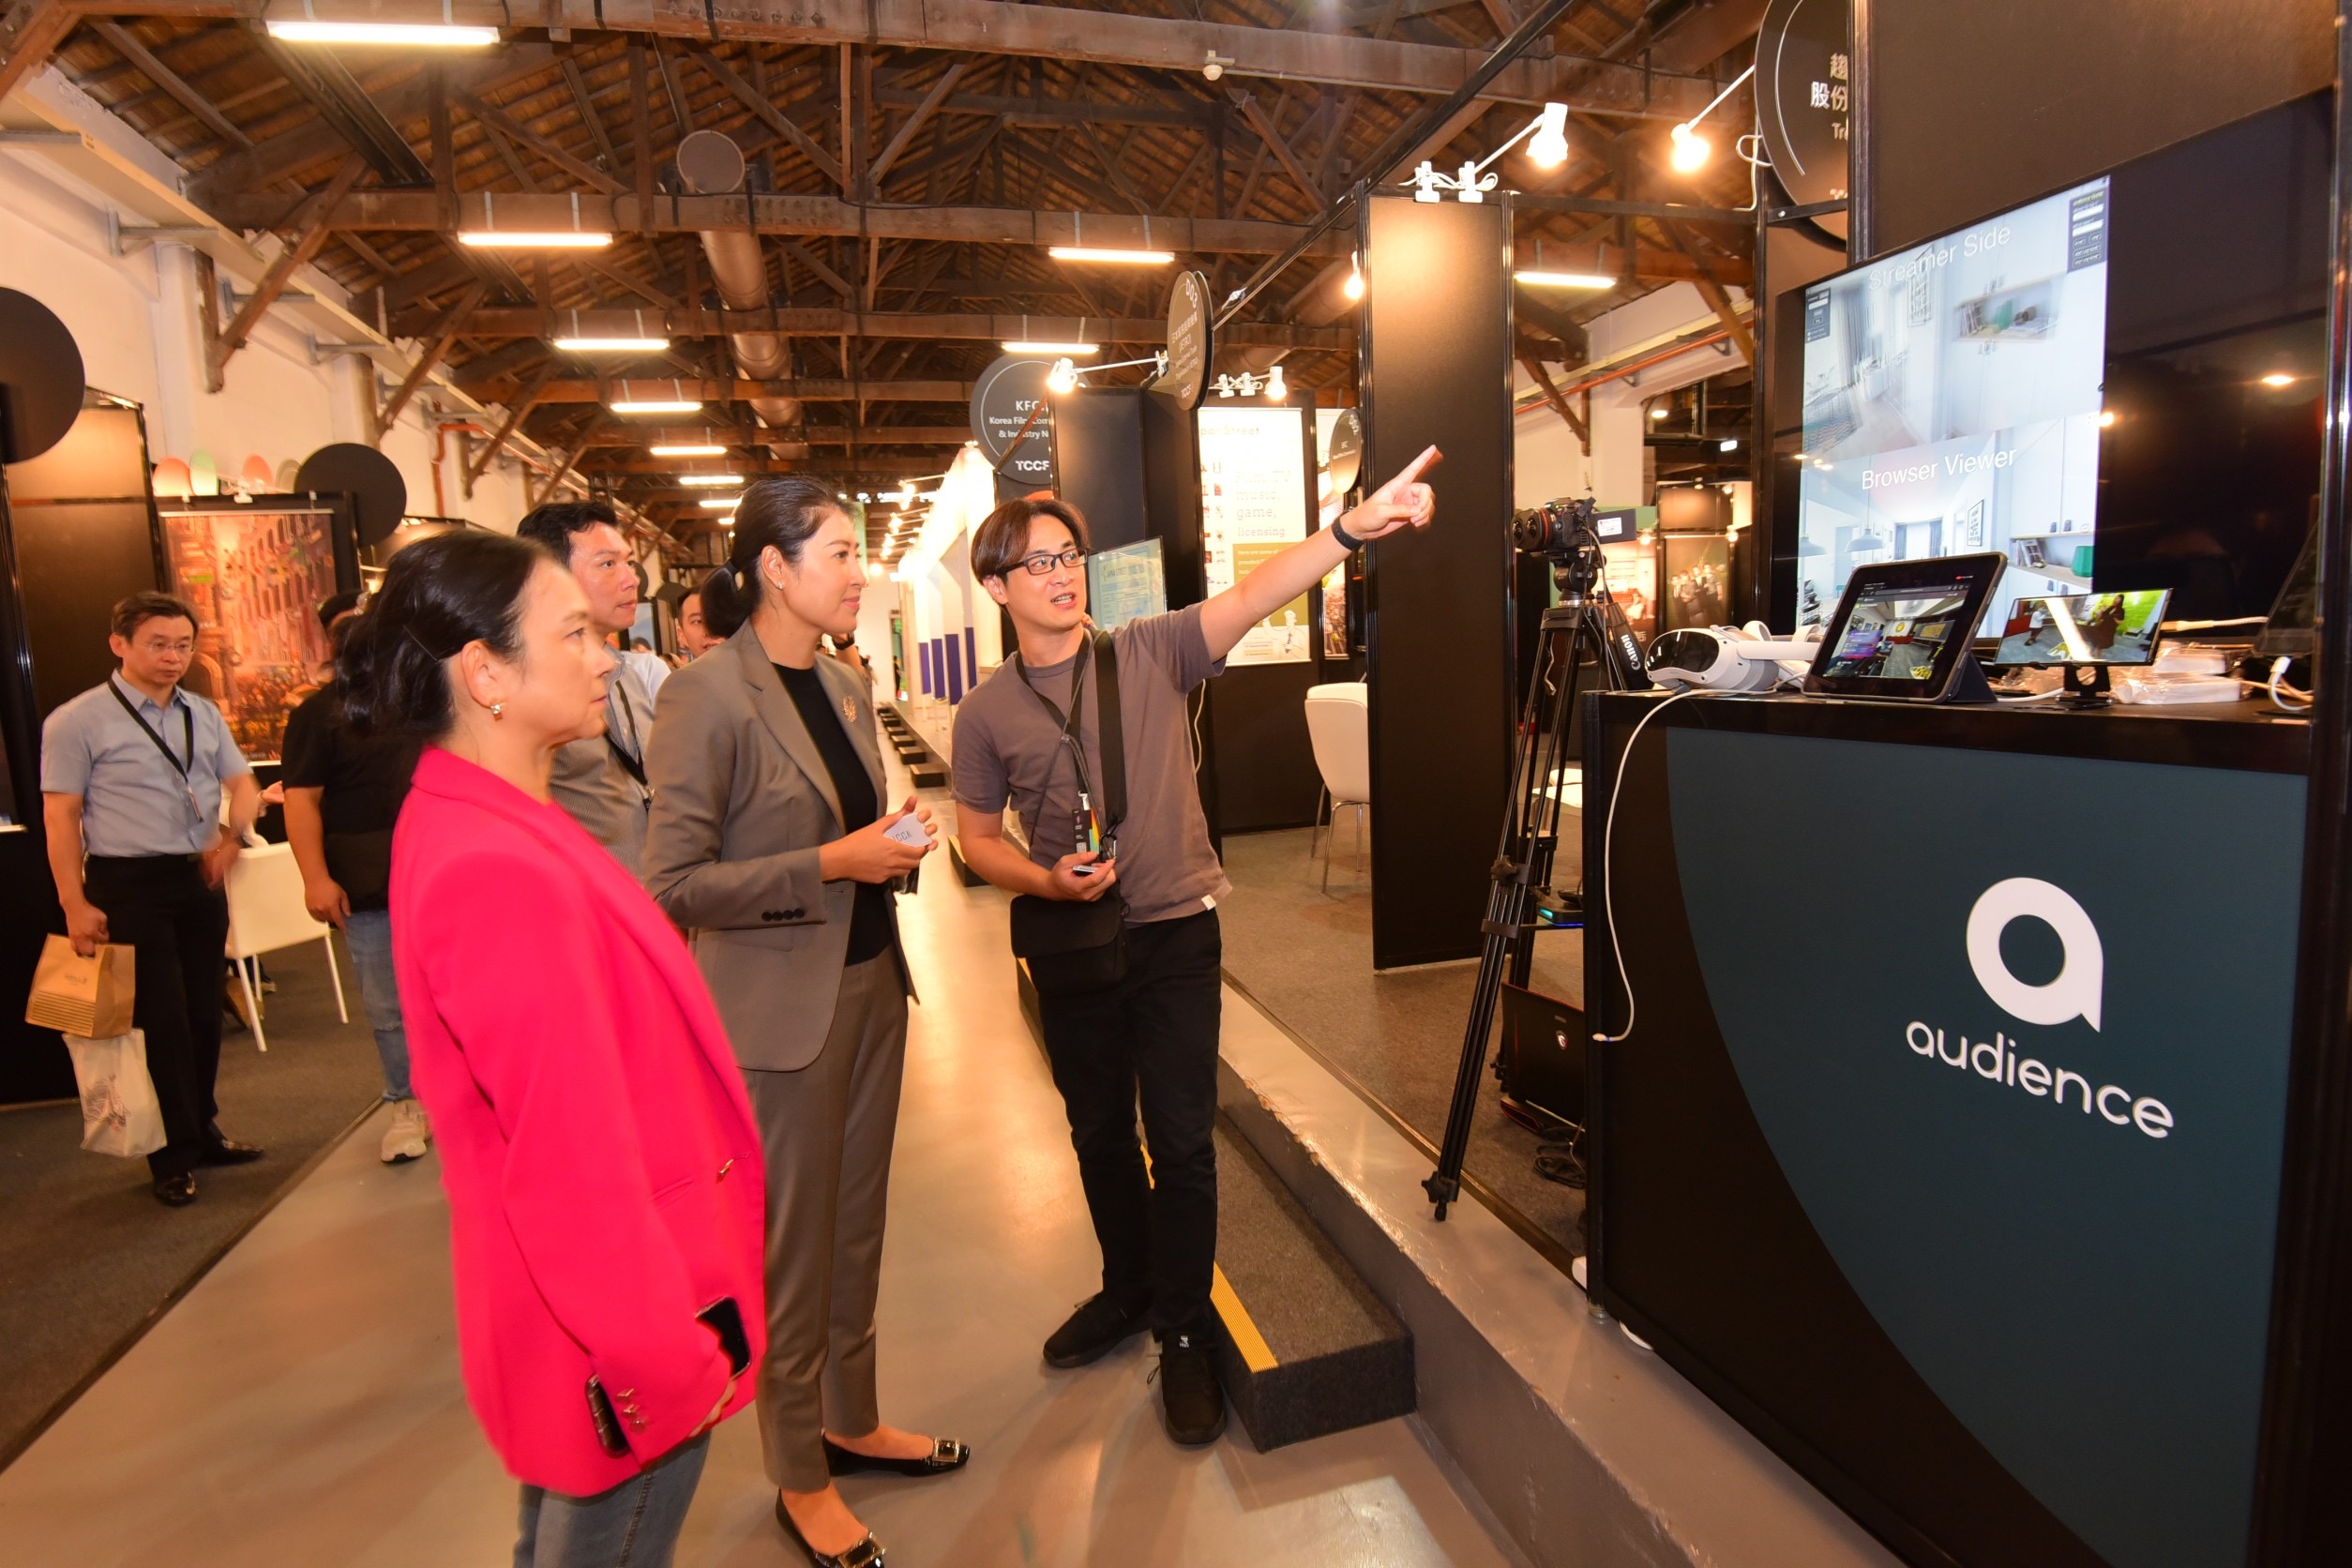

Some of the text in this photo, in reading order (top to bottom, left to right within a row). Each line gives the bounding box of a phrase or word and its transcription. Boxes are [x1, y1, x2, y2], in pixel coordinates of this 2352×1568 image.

[1868, 224, 2012, 292] Streamer Side
[988, 416, 1013, 425] Korea
[1007, 430, 1040, 440] Indstry
[1015, 460, 1049, 471] TCCF
[1862, 448, 2017, 490] Browser Viewer
[1236, 508, 1276, 521] game,
[1238, 527, 1286, 538] licensing
[1621, 634, 1641, 671] Canon
[1906, 1020, 2174, 1138] audience
